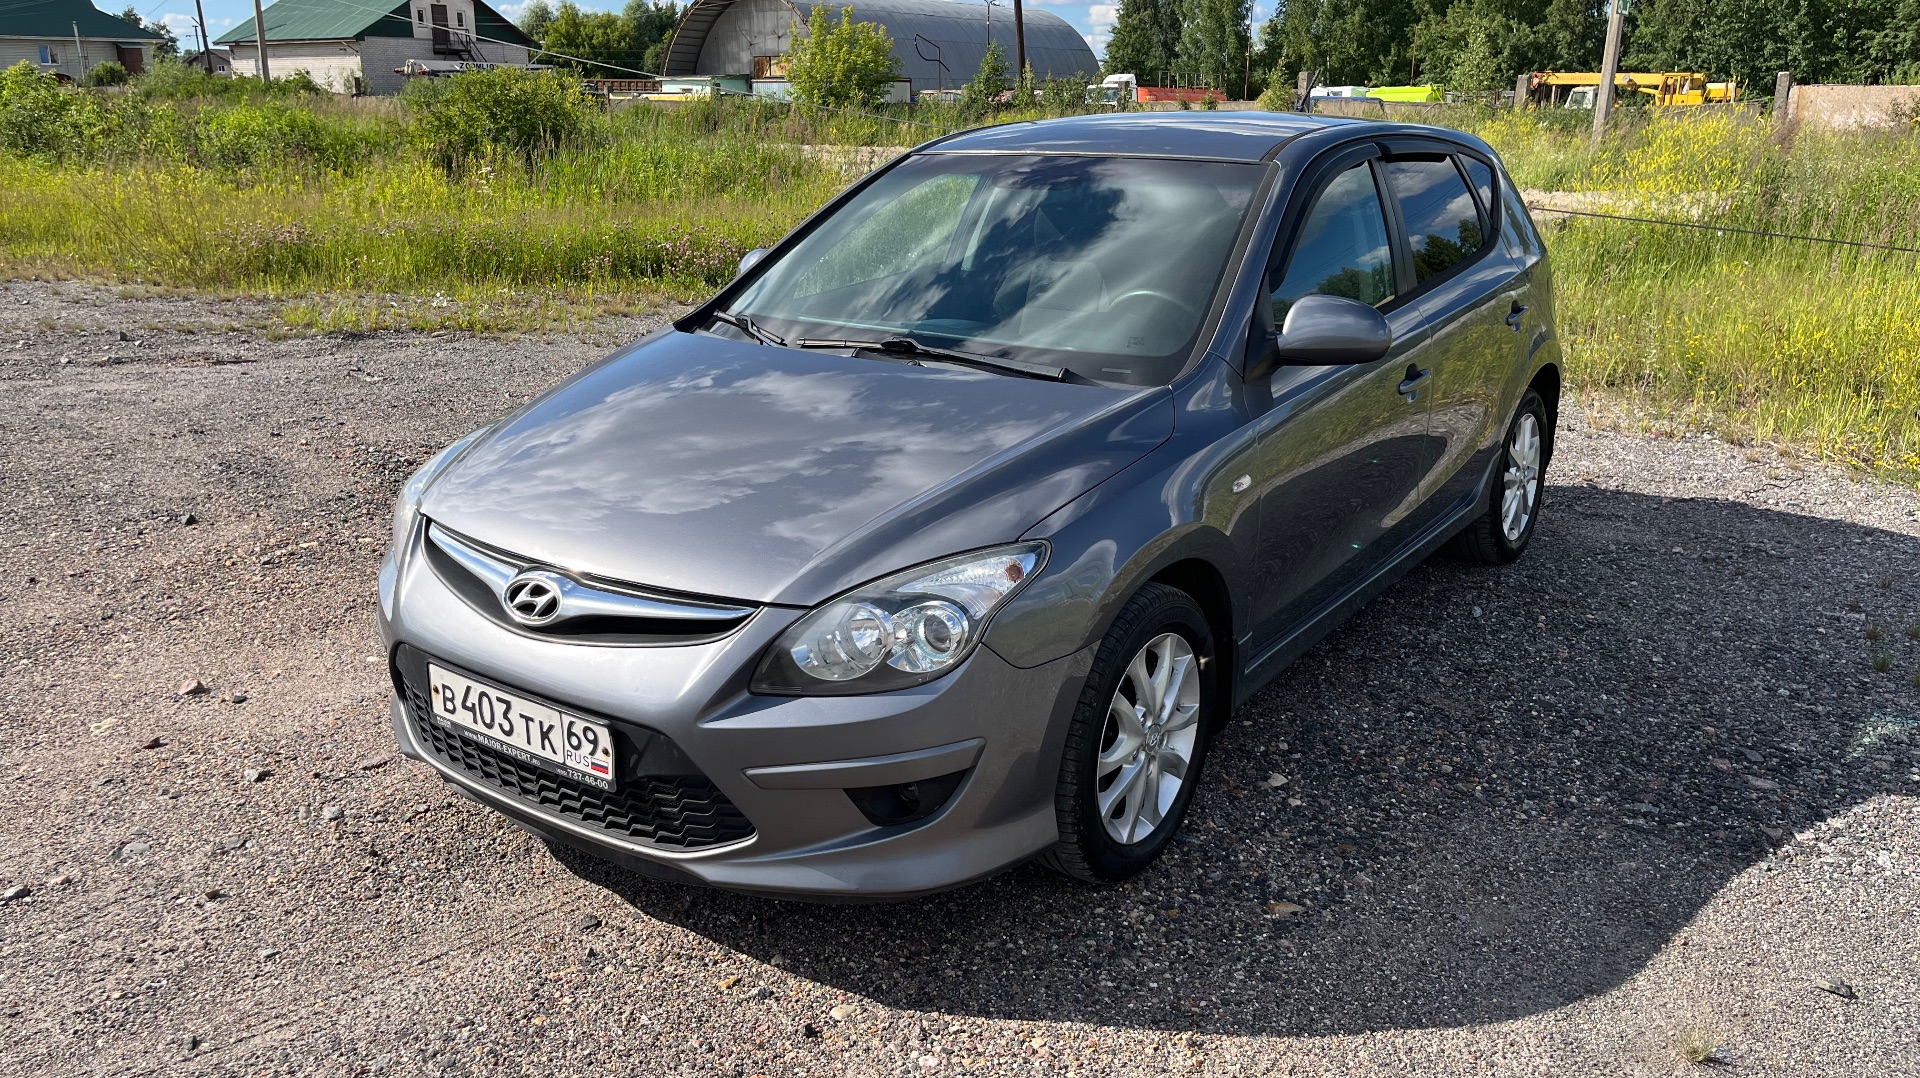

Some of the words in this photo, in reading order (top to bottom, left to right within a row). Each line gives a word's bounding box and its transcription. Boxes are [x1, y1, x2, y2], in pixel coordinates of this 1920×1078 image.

[459, 62, 497, 72] ZOOMLIO
[566, 720, 599, 757] 69
[566, 749, 590, 768] RUS
[567, 769, 609, 790] 737-46-00
